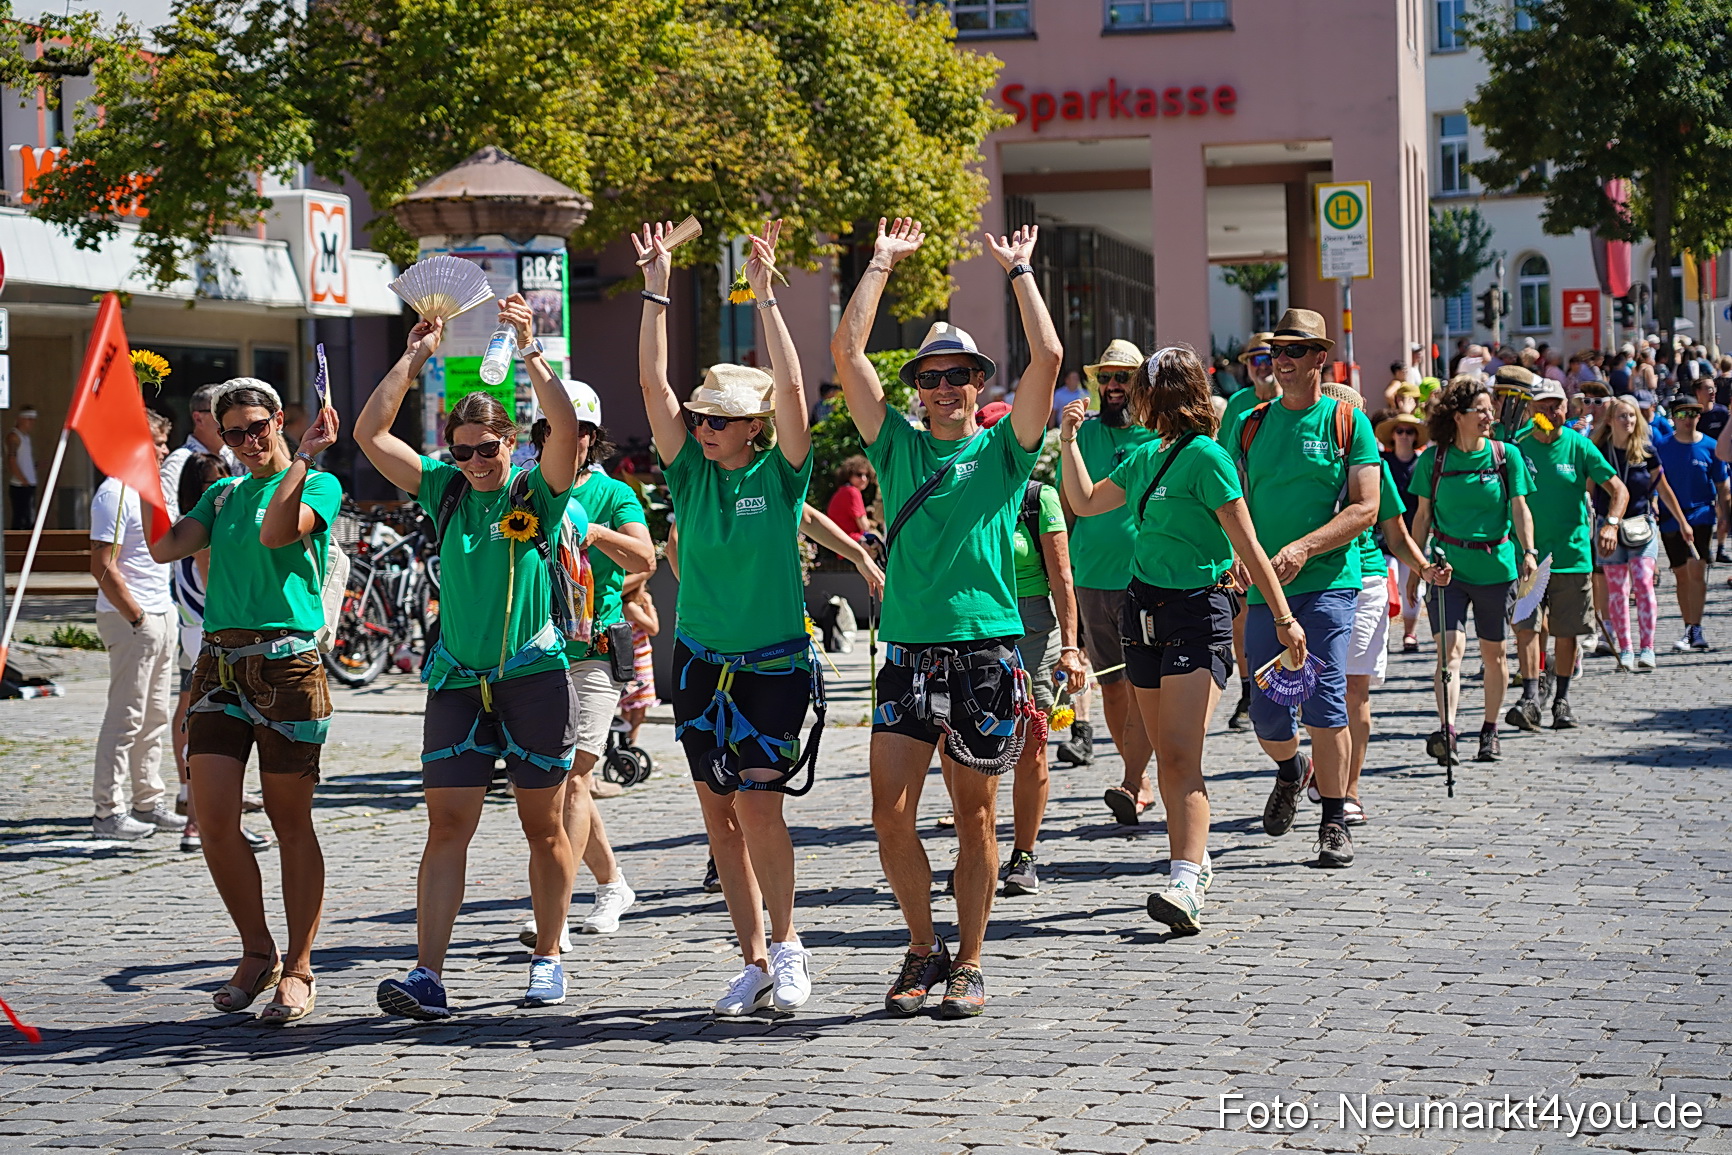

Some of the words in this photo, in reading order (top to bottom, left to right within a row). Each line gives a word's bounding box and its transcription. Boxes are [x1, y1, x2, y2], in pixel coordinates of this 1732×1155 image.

[1001, 77, 1238, 133] Sparkasse
[1335, 198, 1352, 221] H
[1311, 441, 1328, 449] DAV
[744, 498, 765, 507] DAV
